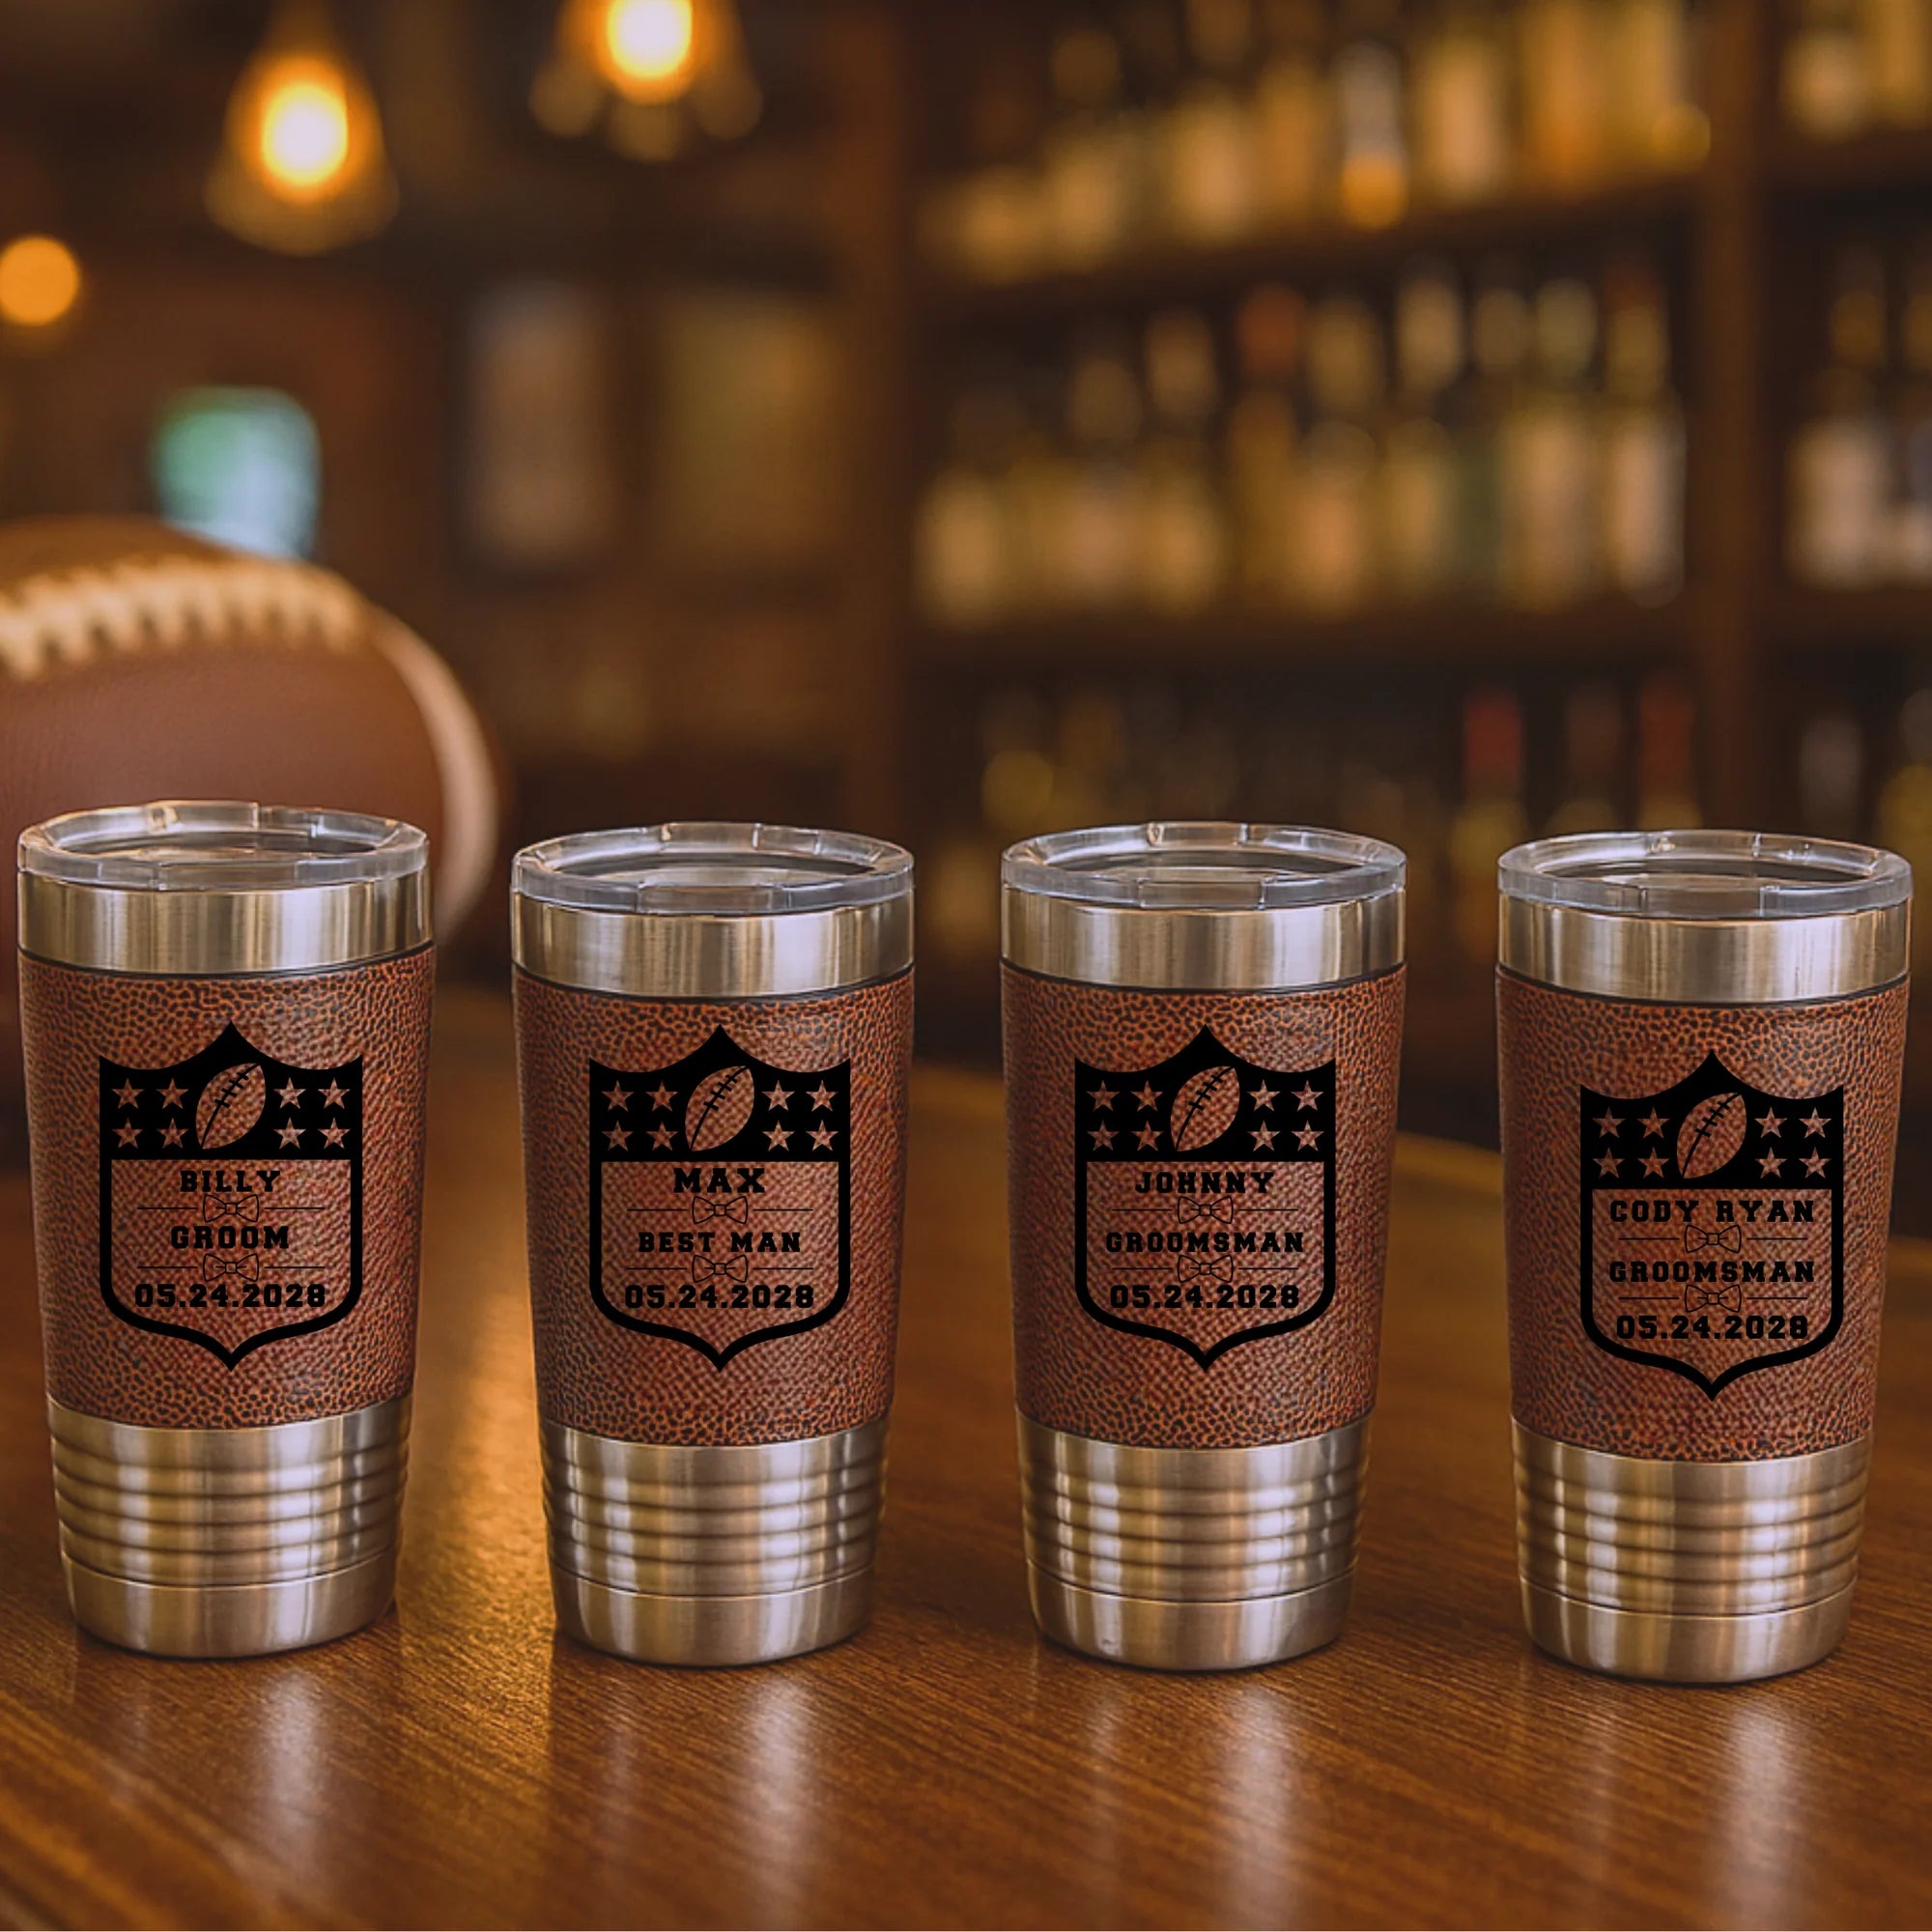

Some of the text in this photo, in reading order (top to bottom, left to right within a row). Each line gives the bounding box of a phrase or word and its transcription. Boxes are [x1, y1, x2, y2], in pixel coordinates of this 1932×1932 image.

[180, 1170, 281, 1192] BILLY
[673, 1167, 765, 1193] MAX
[1135, 1171, 1274, 1194] JOHNNY
[1609, 1200, 1814, 1223] CODY RYAN
[170, 1225, 290, 1249] GROOM
[638, 1232, 801, 1253] BEST MAN
[1106, 1232, 1303, 1253] GROOMSMAN
[1609, 1261, 1814, 1283] GROOMSMAN
[135, 1283, 326, 1308] 05.24.2028
[625, 1284, 814, 1309] 05.24.2028
[1110, 1284, 1299, 1309] 05.24.2028
[1616, 1315, 1808, 1340] 05.24.2028
